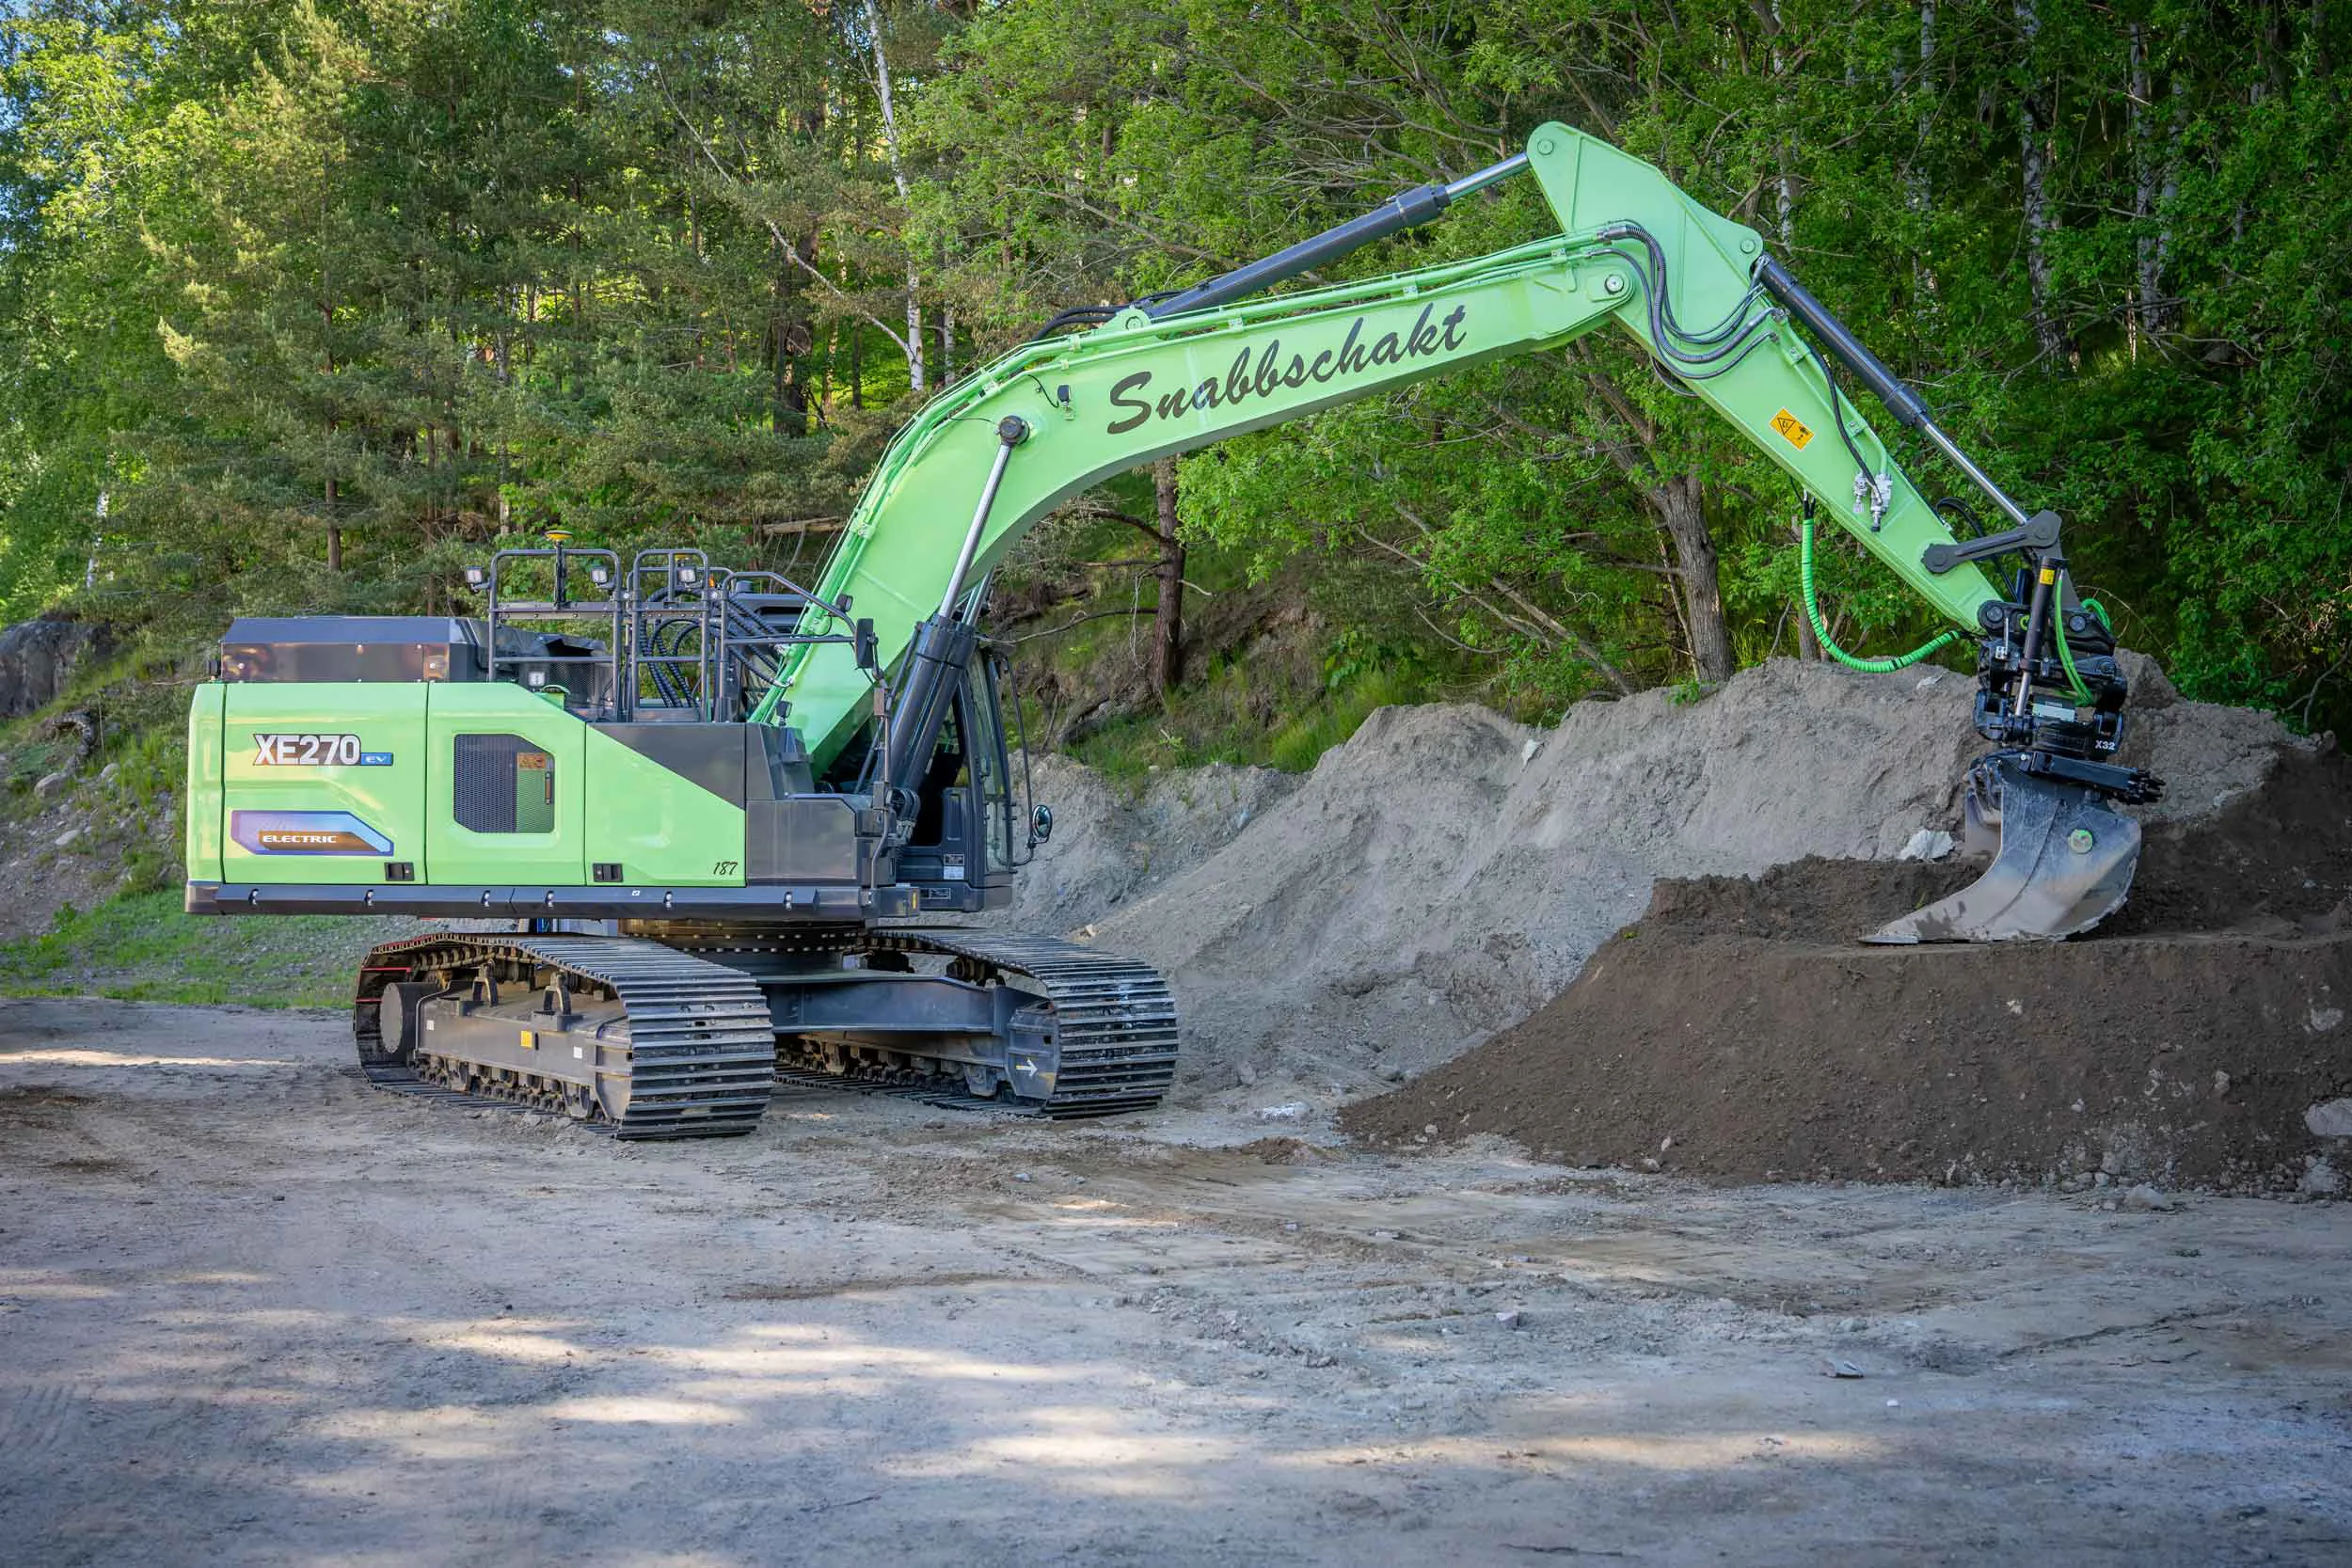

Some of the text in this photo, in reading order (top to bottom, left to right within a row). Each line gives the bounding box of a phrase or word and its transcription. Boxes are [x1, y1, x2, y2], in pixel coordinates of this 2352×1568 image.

[1106, 301, 1468, 436] Snabbschakt
[255, 735, 387, 765] XE270 EV
[2094, 739, 2116, 751] X32
[713, 861, 739, 875] 187
